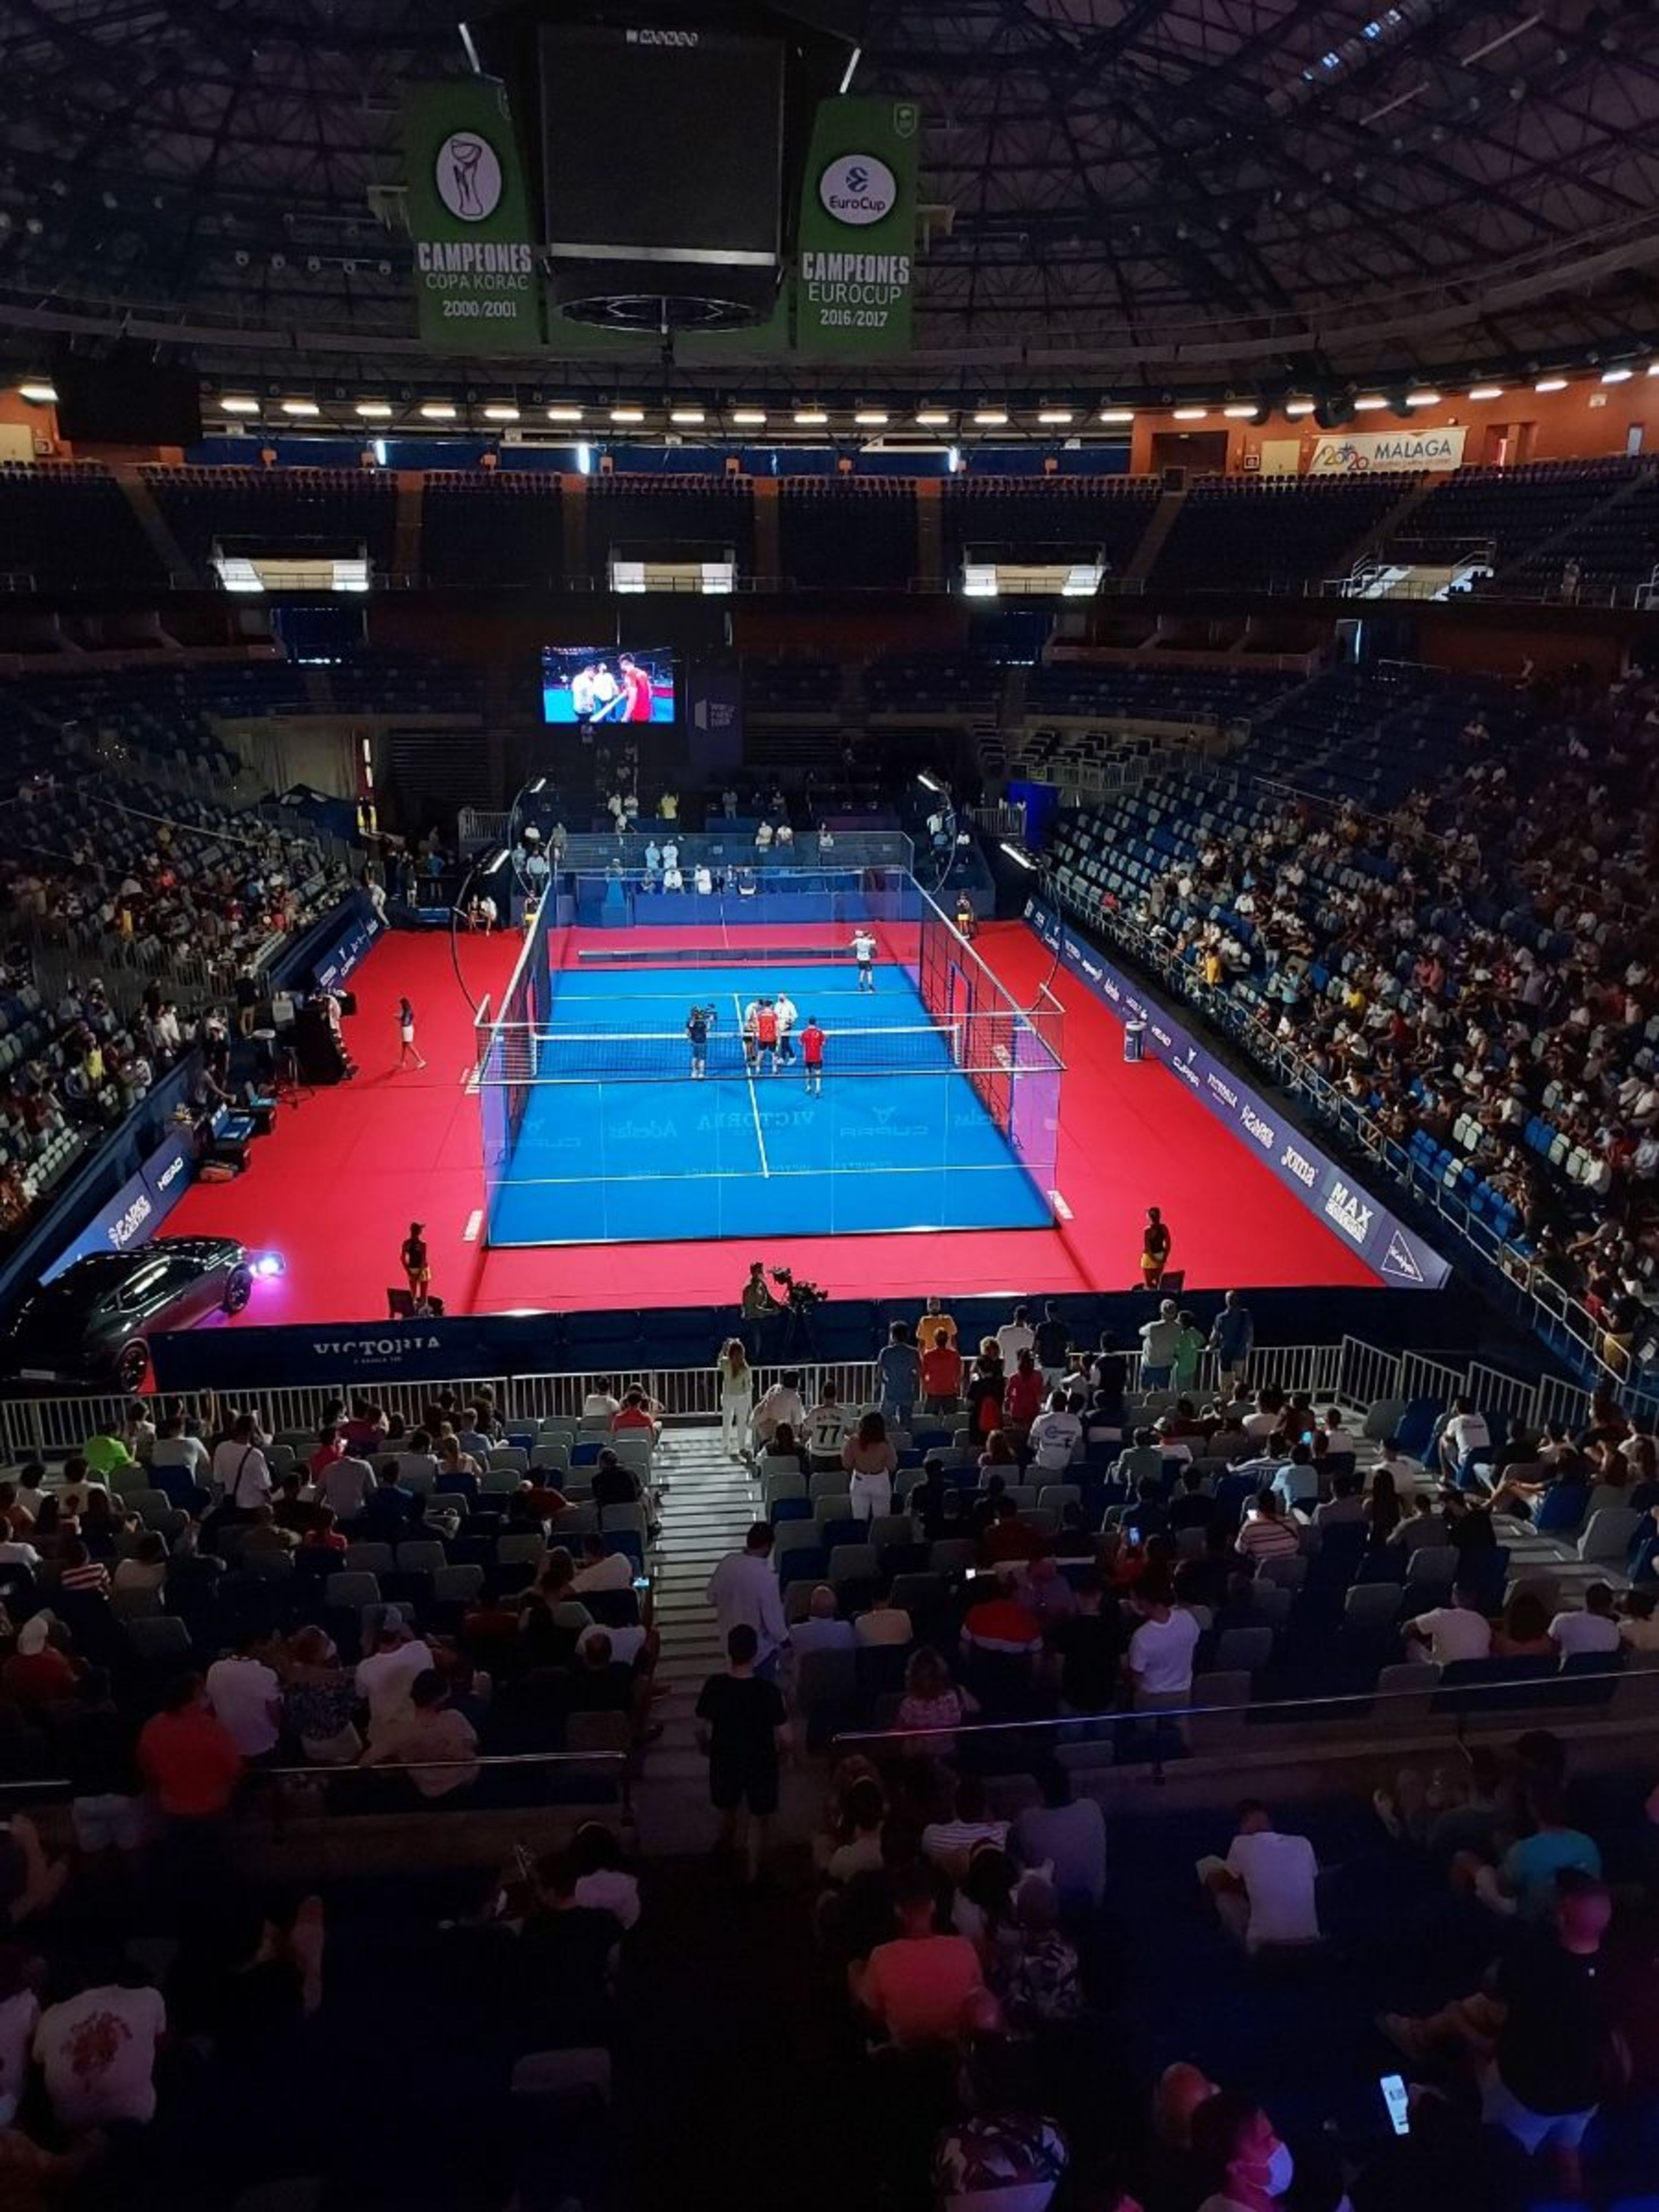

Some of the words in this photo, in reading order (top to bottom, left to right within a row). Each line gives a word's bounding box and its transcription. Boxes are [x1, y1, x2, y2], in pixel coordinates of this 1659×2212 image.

[829, 195, 886, 212] EuroCup
[418, 242, 531, 273] CAMPEONES
[803, 252, 909, 284] CAMPEONES
[426, 273, 470, 290] COPA
[808, 282, 902, 305] EUROCUP
[442, 300, 517, 318] 2000/2001
[820, 309, 889, 327] 2016/2017
[157, 1157, 183, 1191] HEAD
[1331, 1181, 1374, 1230] MAX
[817, 1424, 841, 1444] 77
